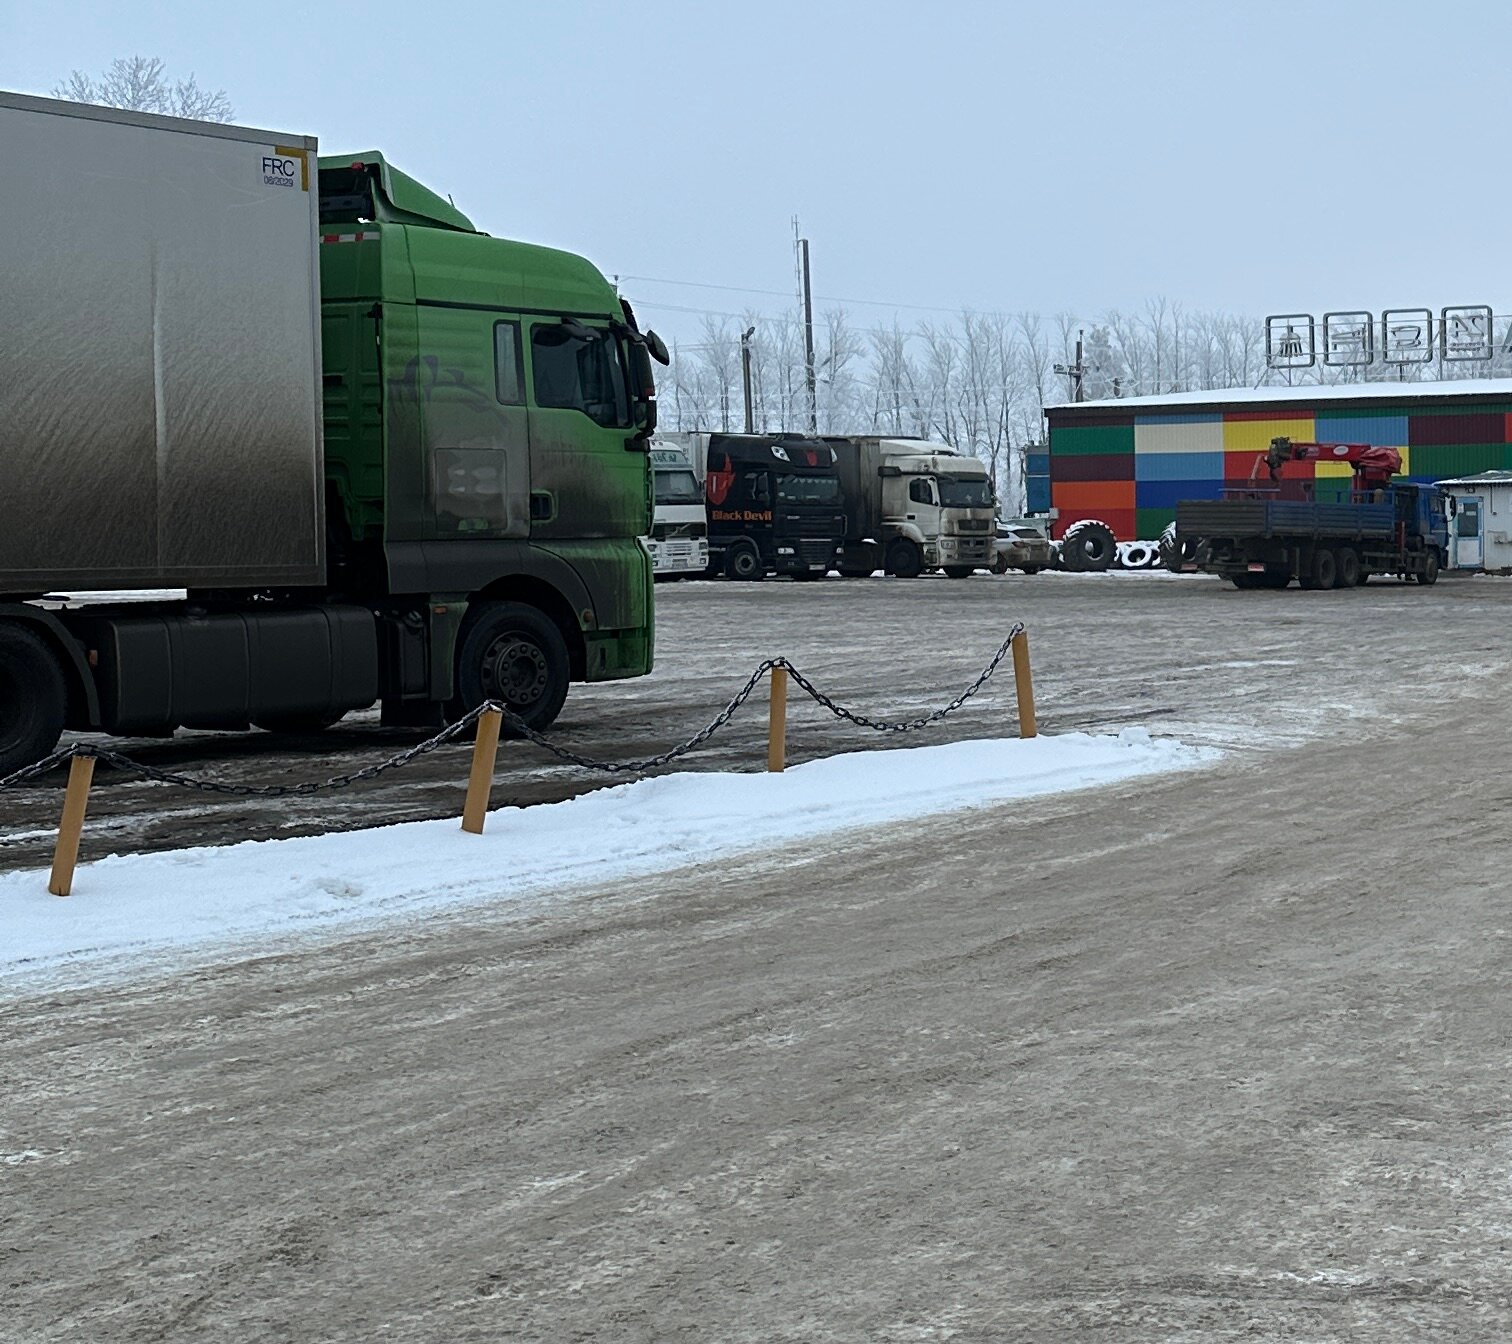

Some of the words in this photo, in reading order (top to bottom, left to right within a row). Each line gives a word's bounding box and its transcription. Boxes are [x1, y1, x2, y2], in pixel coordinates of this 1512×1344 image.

[262, 156, 295, 177] FRC
[712, 510, 742, 521] Black
[743, 510, 773, 521] Devil
